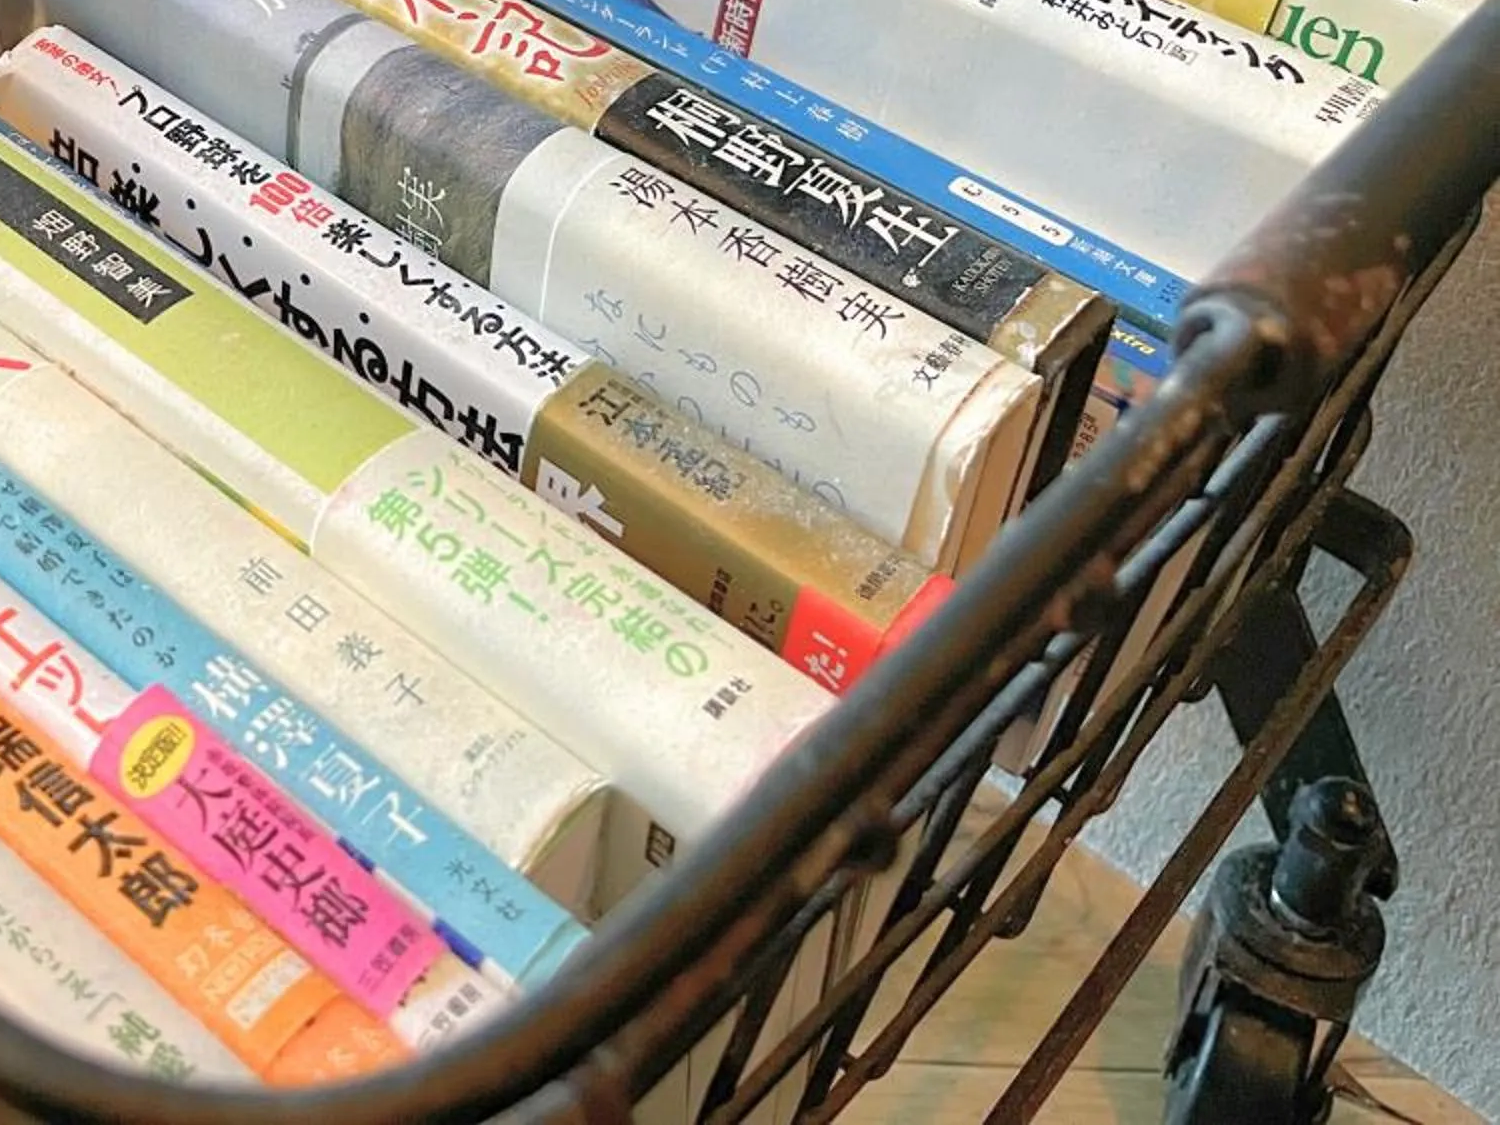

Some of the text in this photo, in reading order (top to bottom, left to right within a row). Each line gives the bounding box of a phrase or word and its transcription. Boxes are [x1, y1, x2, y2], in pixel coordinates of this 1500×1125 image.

[32, 209, 173, 308] 畑野智美
[610, 165, 906, 340] 湯本香樹実
[645, 84, 961, 270] 桐野夏生
[406, 464, 710, 679] シリーズ完結の
[191, 651, 432, 849] 横澤夏子
[441, 856, 526, 924] 光文社
